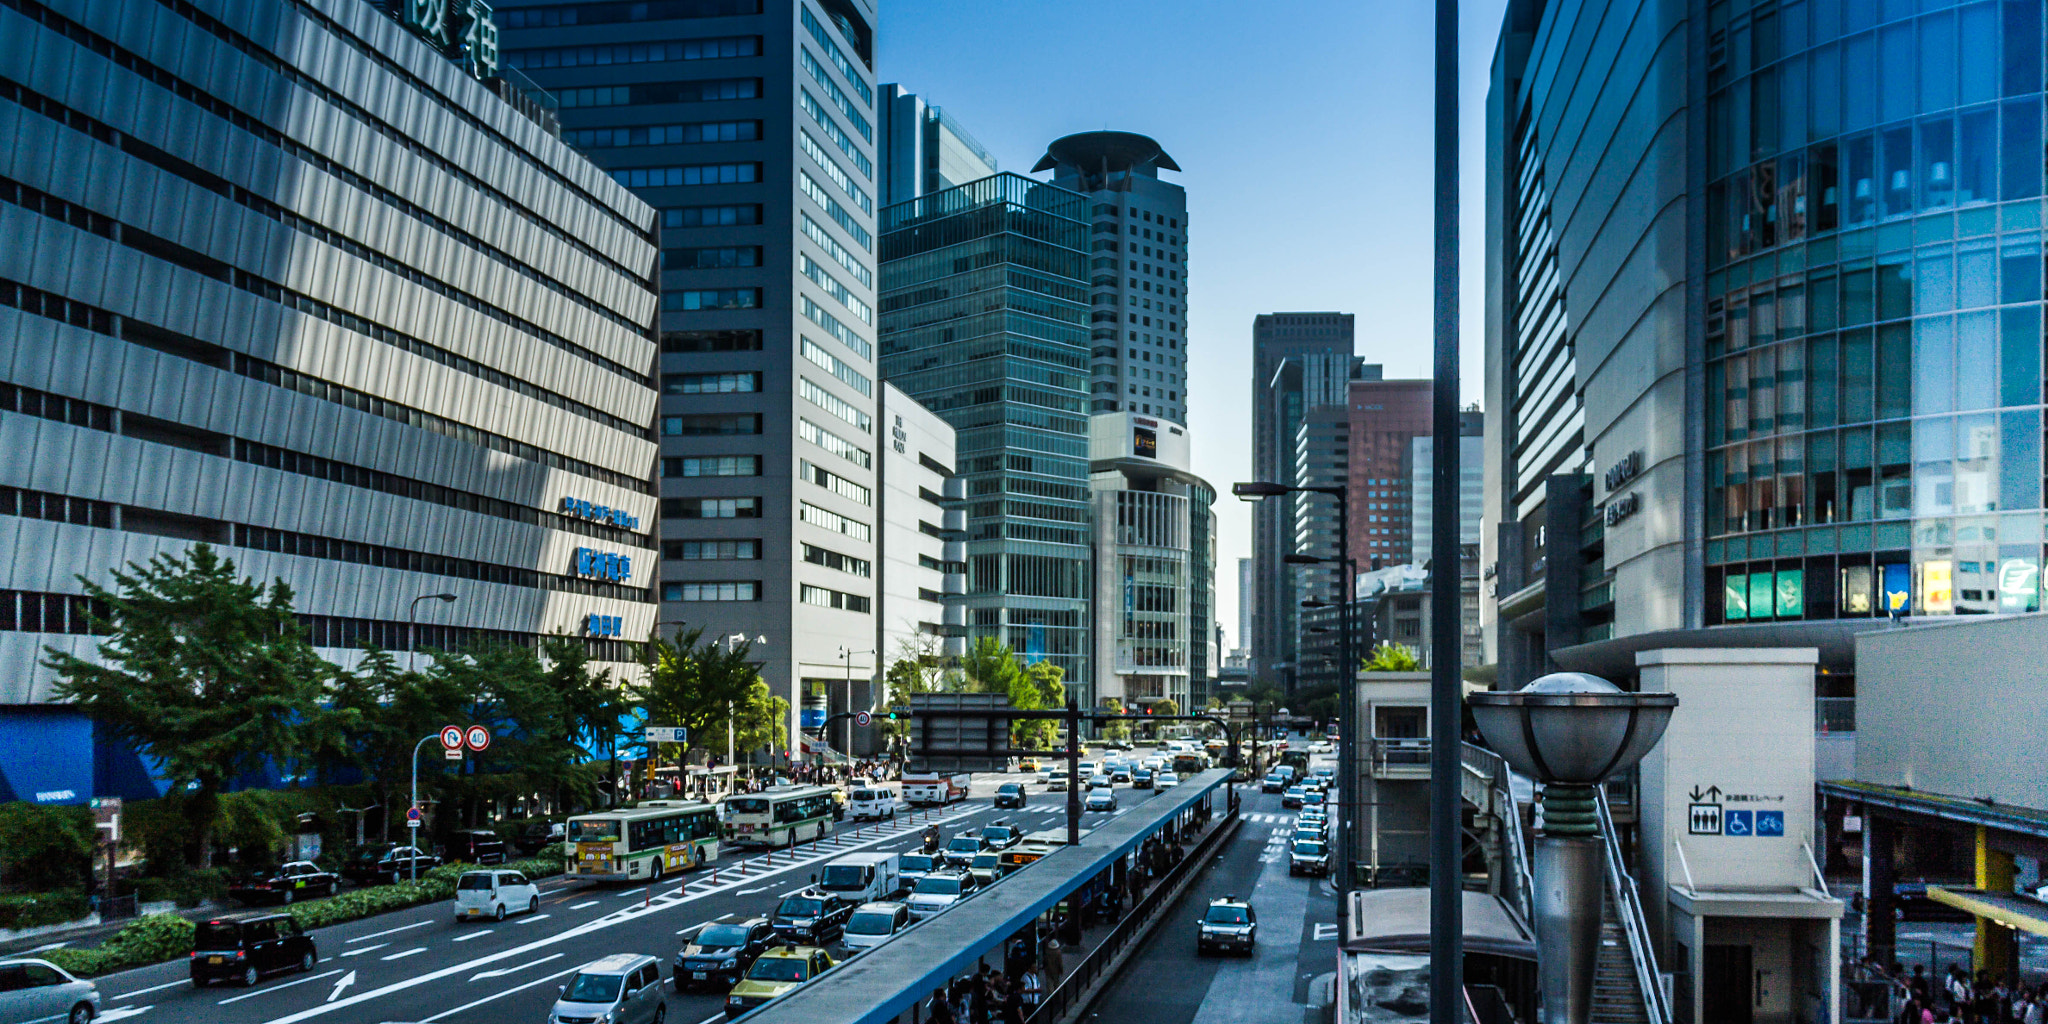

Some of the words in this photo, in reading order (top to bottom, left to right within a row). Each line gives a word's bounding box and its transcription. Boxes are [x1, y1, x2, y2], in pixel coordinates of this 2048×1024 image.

[578, 547, 631, 581] 阪神電車
[589, 613, 622, 637] 梅田駅
[471, 733, 484, 743] 40
